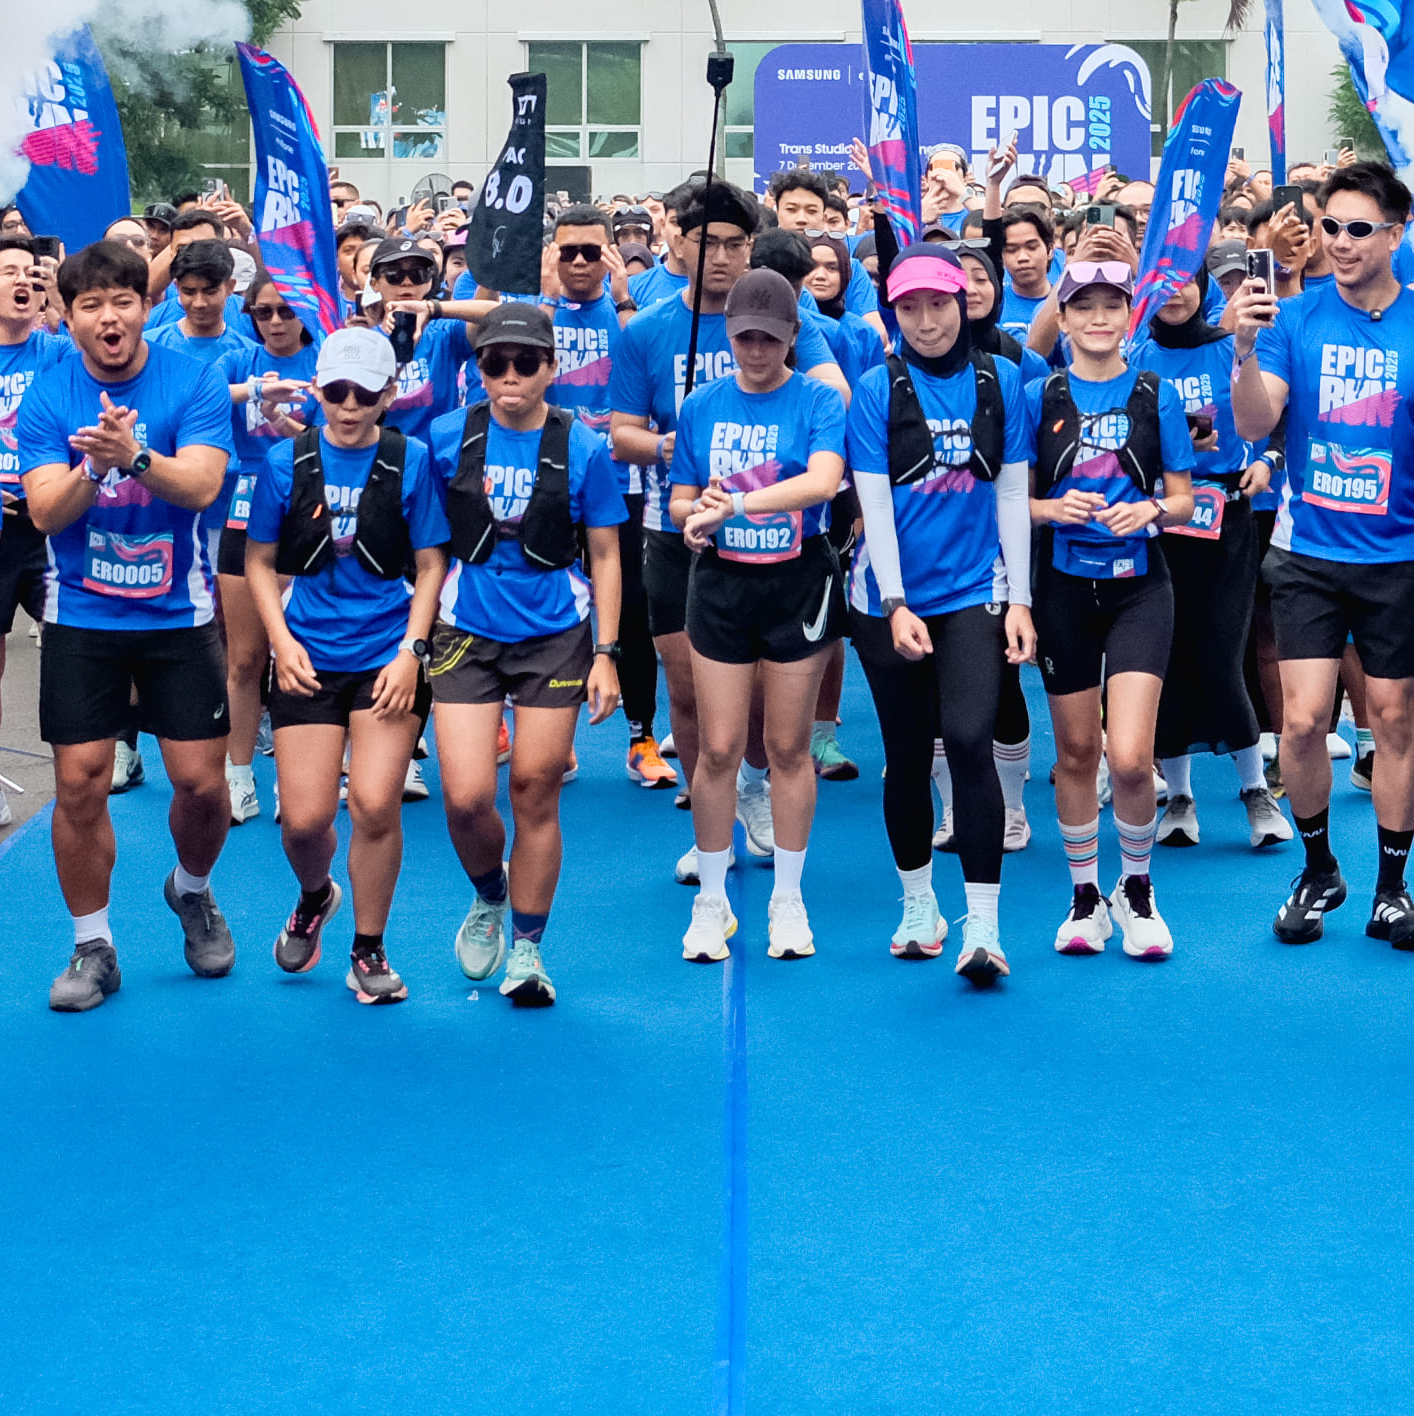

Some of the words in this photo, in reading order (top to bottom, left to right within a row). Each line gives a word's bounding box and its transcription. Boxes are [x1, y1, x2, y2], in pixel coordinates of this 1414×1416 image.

[777, 69, 841, 80] SAMSUNG
[971, 95, 1085, 151] EPIC
[1089, 95, 1111, 150] 2025
[779, 143, 812, 154] Trans
[779, 160, 786, 170] 7
[555, 327, 598, 352] EPIC
[598, 328, 609, 351] 2025
[1321, 344, 1384, 380] EPIC
[1385, 350, 1399, 380] 2025
[1318, 375, 1403, 428] RUN
[710, 422, 767, 451] EPIC
[1313, 470, 1378, 501] ER0195
[724, 526, 791, 550] ER0192
[91, 557, 164, 585] ER0005
